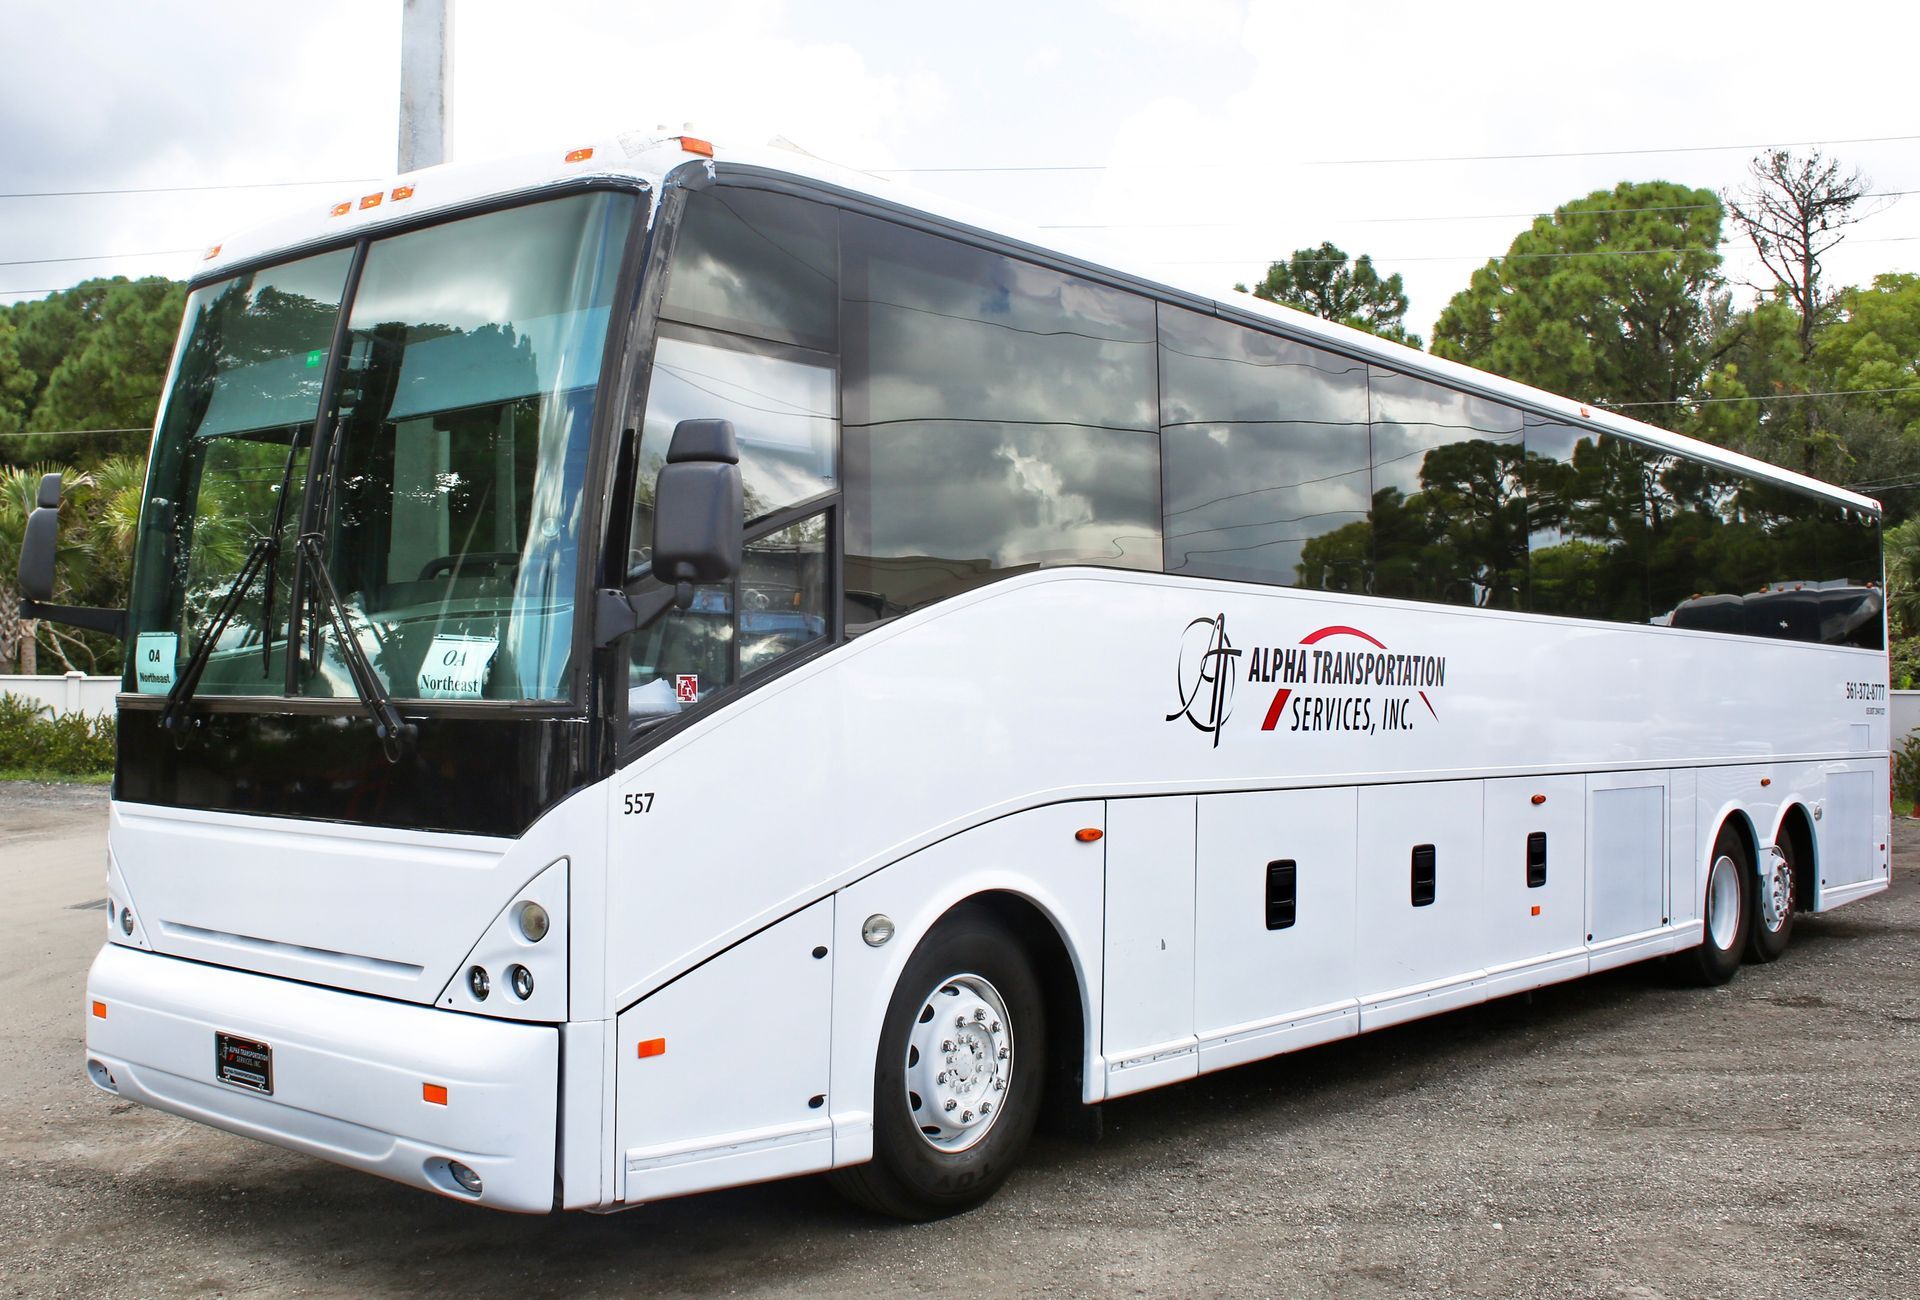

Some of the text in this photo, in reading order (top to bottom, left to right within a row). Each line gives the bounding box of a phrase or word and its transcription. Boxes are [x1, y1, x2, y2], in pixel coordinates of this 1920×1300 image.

[149, 649, 160, 662] OA
[443, 650, 467, 667] OA
[1248, 647, 1446, 687] ALPHA TRANSPORTATION
[140, 672, 170, 683] Northeast
[421, 674, 478, 692] Northeast
[1846, 682, 1885, 701] 561-372-8777
[1291, 697, 1414, 735] SERVICES, INC.
[624, 792, 655, 815] 557
